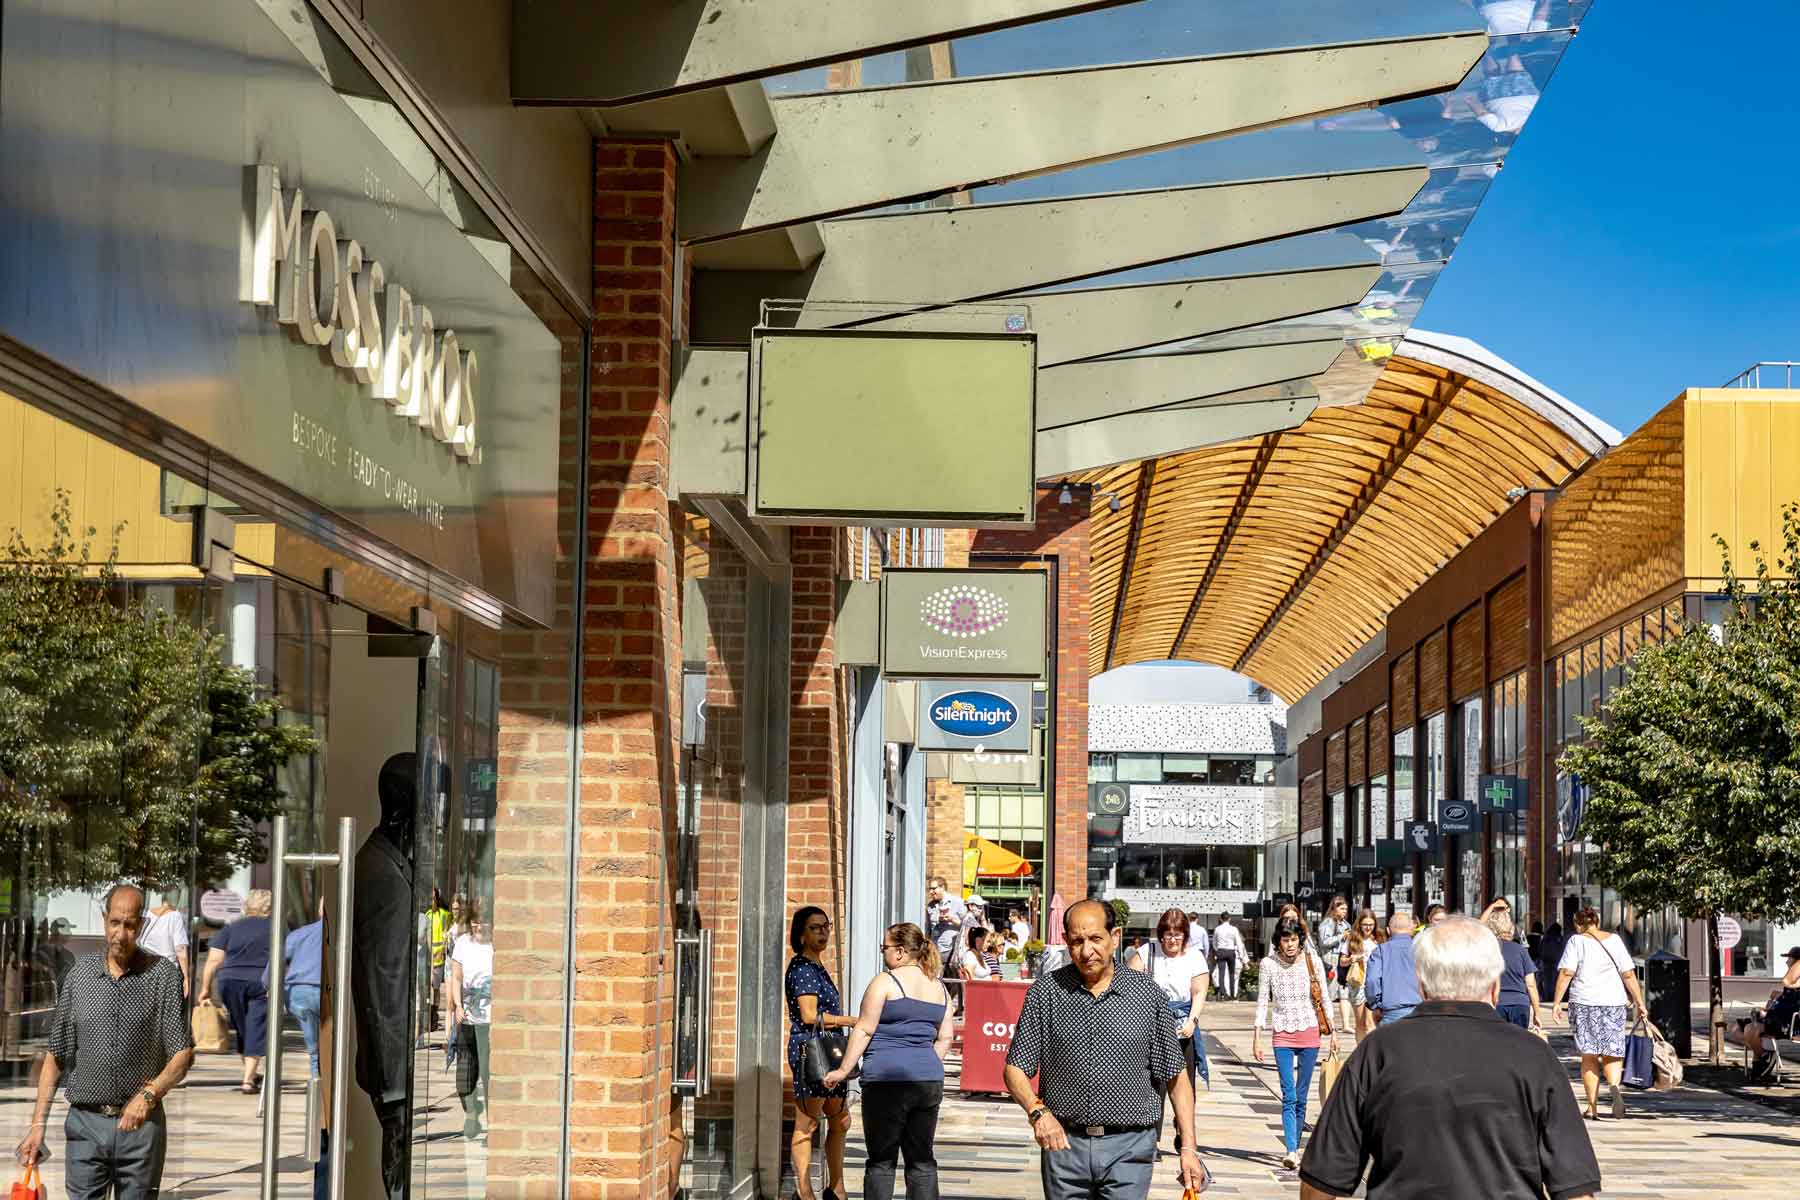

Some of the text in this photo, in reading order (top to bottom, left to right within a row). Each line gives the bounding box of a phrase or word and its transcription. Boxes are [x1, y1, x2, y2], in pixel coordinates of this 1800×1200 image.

[239, 161, 385, 385] MOSS
[293, 410, 337, 467] BESPOKE
[426, 496, 445, 532] HIRE
[935, 706, 1012, 725] Silentnight
